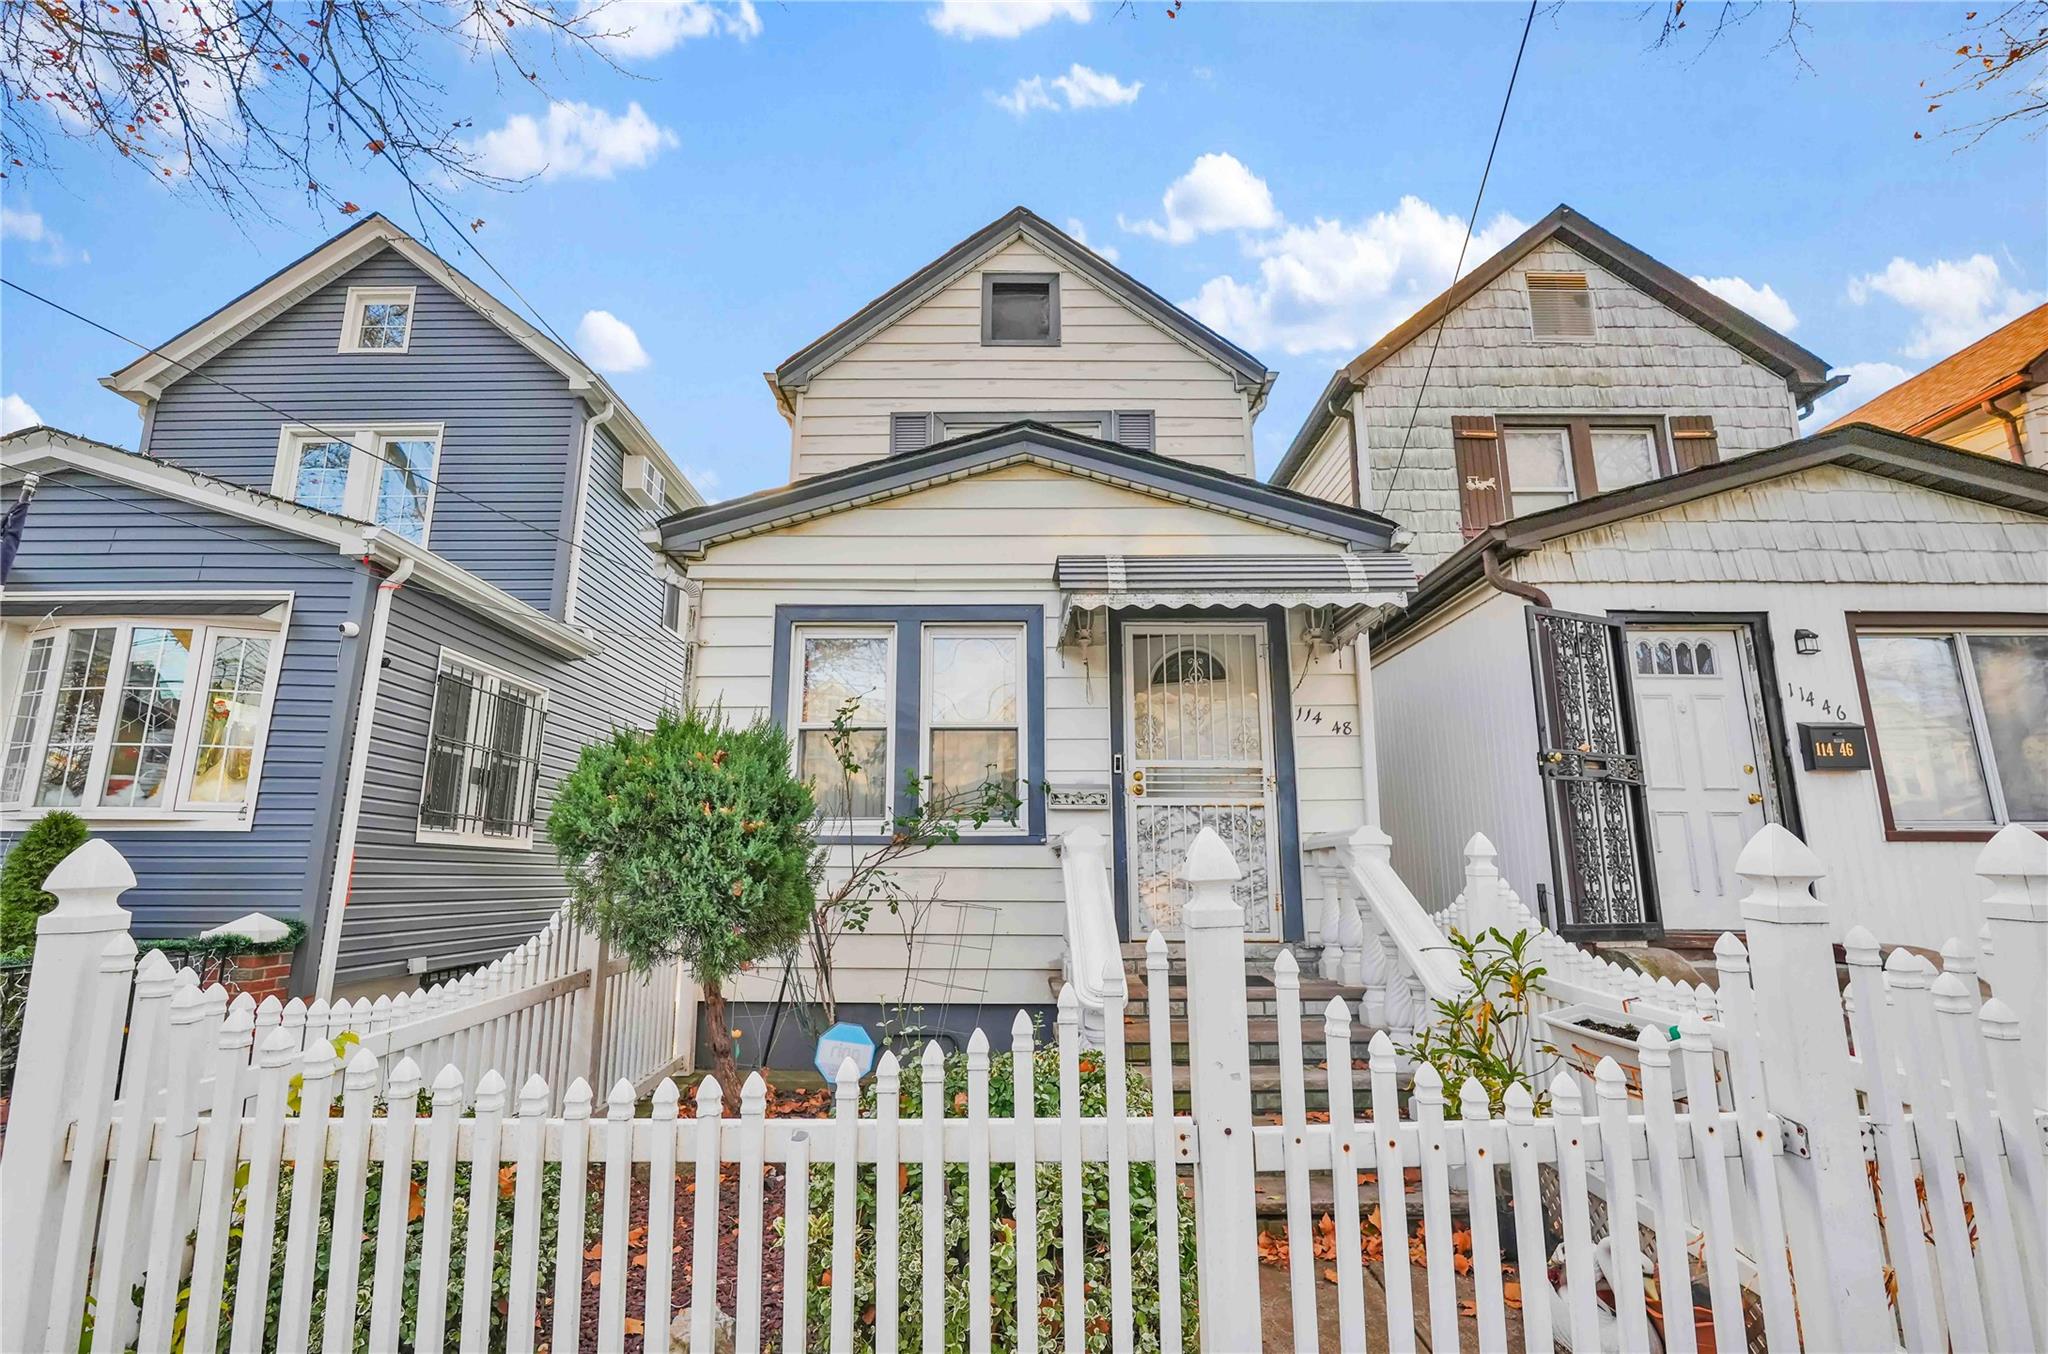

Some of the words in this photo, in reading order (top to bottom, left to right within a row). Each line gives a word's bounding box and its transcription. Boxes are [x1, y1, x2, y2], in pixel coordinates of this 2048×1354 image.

[1296, 707, 1322, 724] 114
[1331, 721, 1352, 735] 48
[1815, 742, 1834, 757] 114
[1839, 742, 1854, 757] 46
